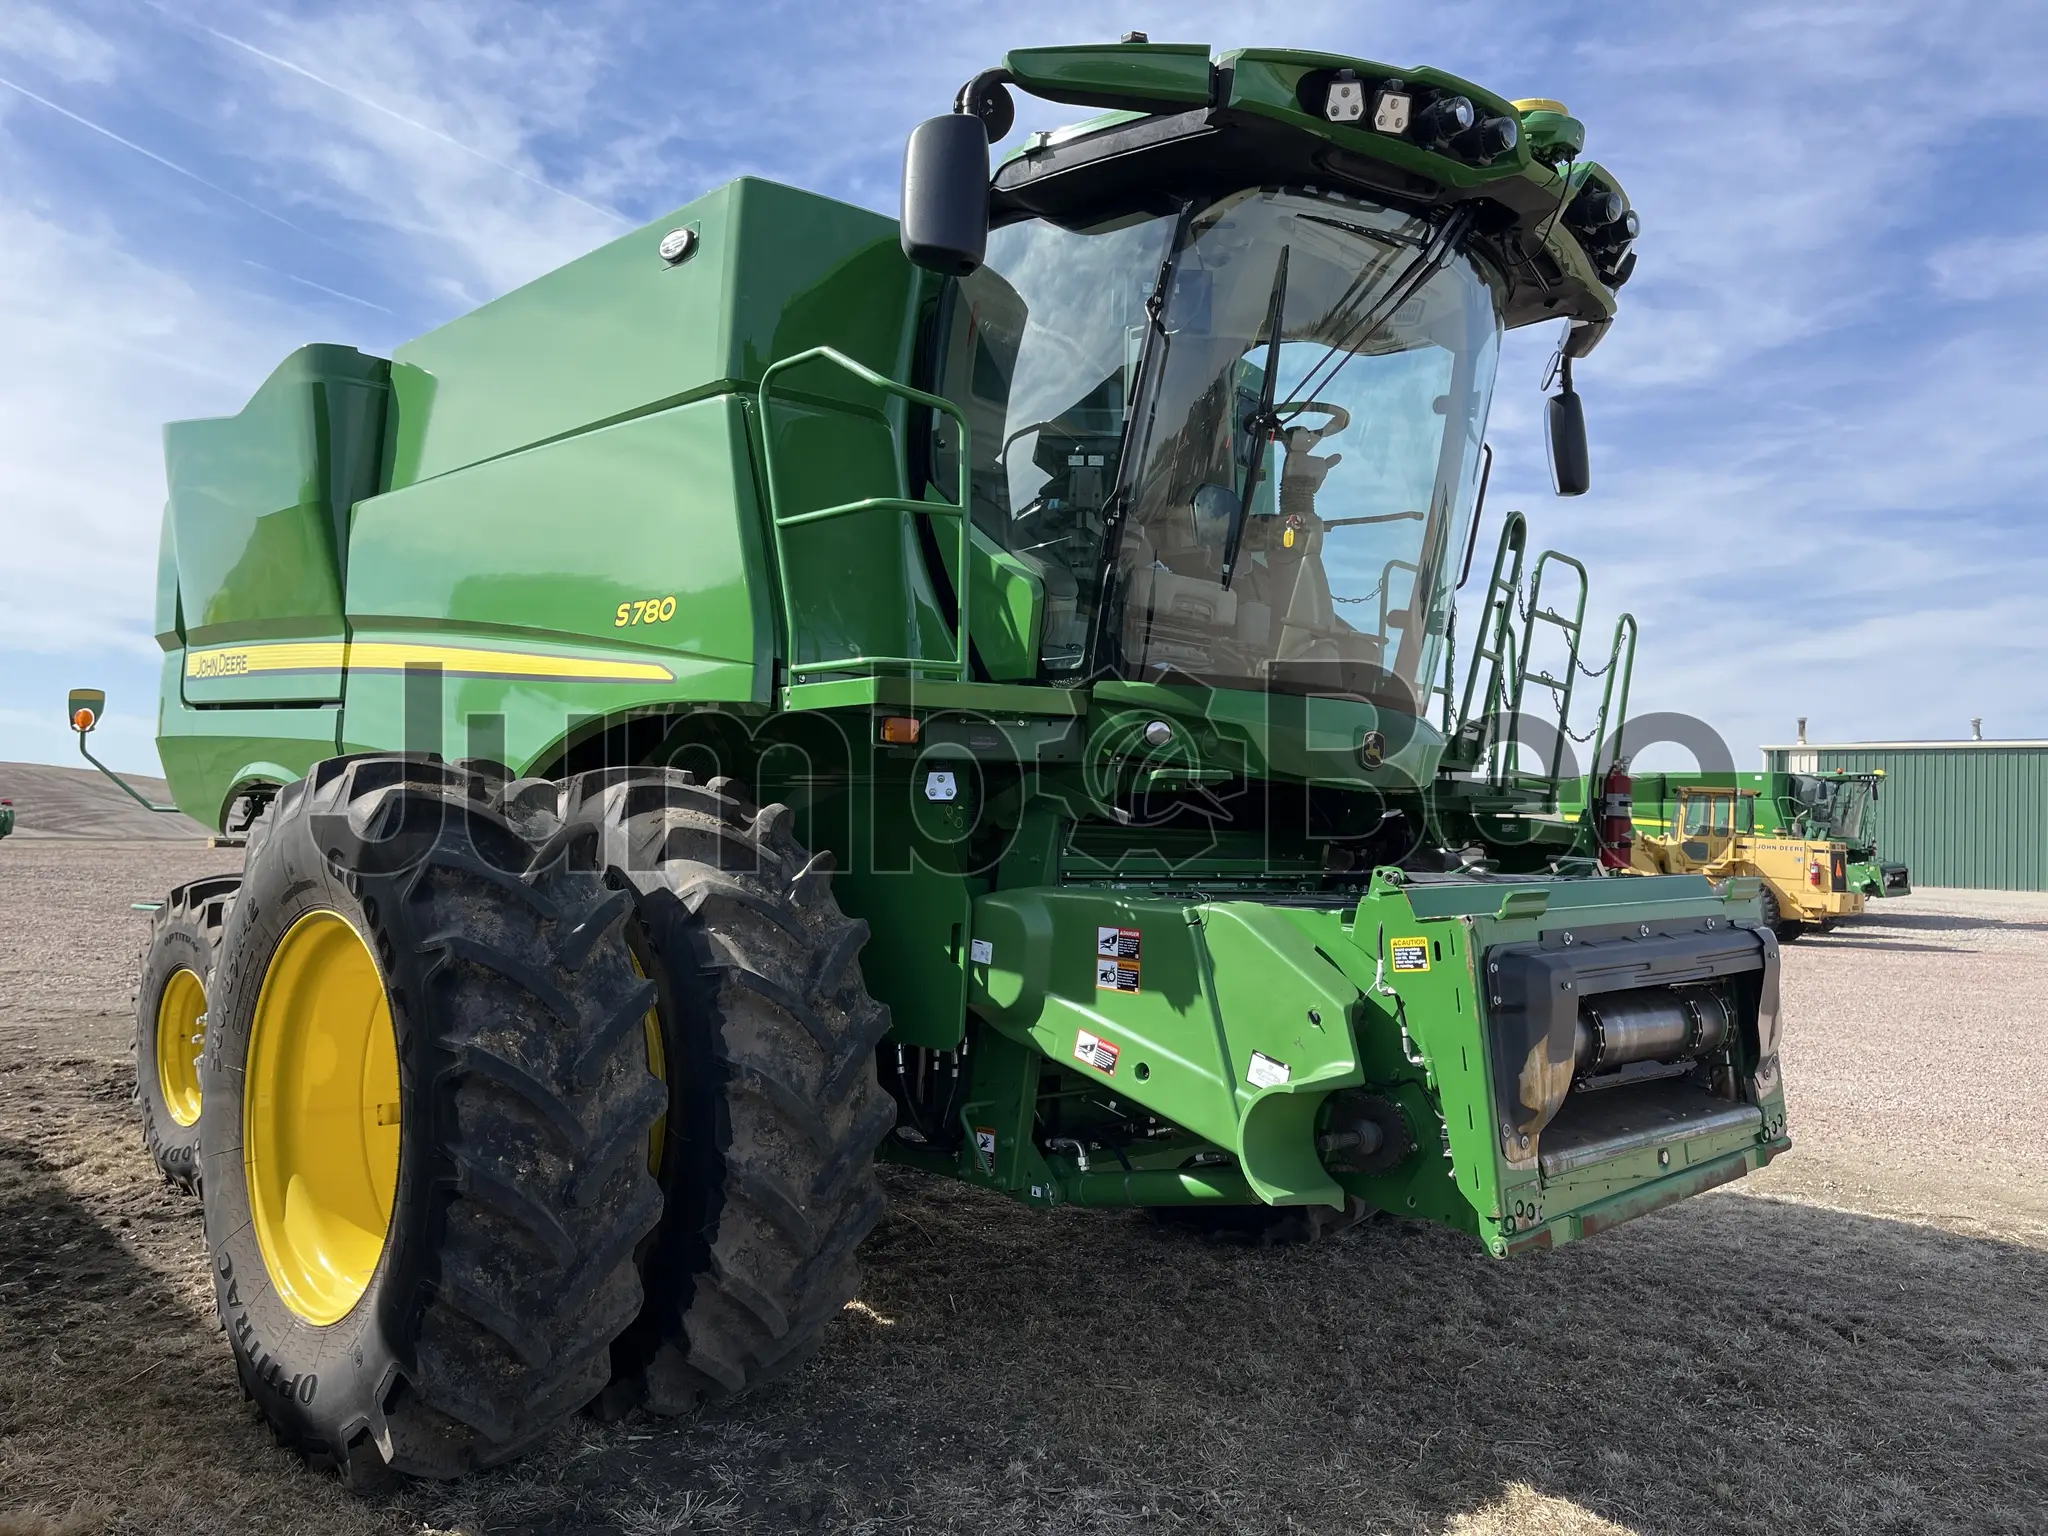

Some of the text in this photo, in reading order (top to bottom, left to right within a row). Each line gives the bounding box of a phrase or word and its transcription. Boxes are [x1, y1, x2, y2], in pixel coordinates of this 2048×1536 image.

[614, 595, 677, 627] S780
[196, 653, 248, 677] JOHN DEERE
[217, 1251, 319, 1406] OPTITRAC
